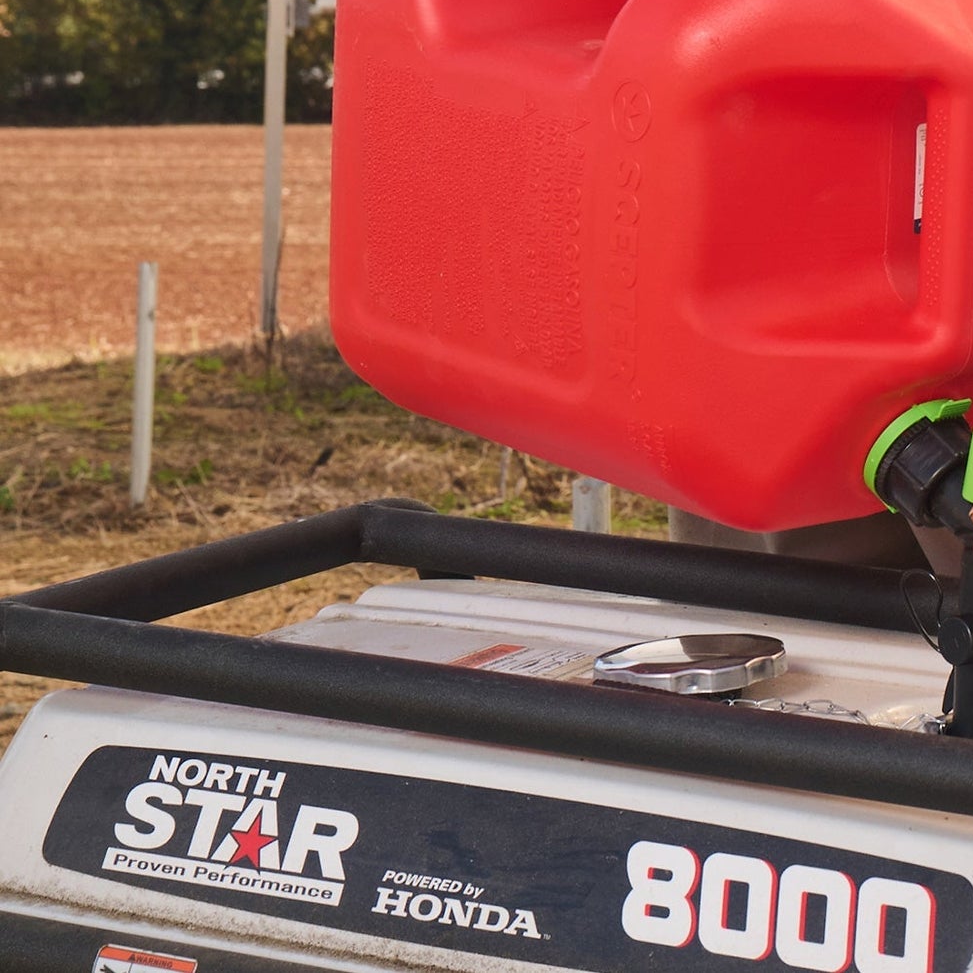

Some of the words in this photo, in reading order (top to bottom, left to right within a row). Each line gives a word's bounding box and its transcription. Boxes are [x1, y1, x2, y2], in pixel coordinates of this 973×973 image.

[610, 154, 642, 385] SCEPTER
[149, 755, 286, 798] NORTH
[114, 782, 359, 881] STAR
[113, 854, 186, 876] Proven
[193, 866, 333, 900] Performance
[382, 870, 463, 893] POWERED
[463, 883, 485, 899] by
[371, 887, 542, 939] HONDA
[622, 840, 937, 973] 8000
[136, 956, 173, 968] WARNING
